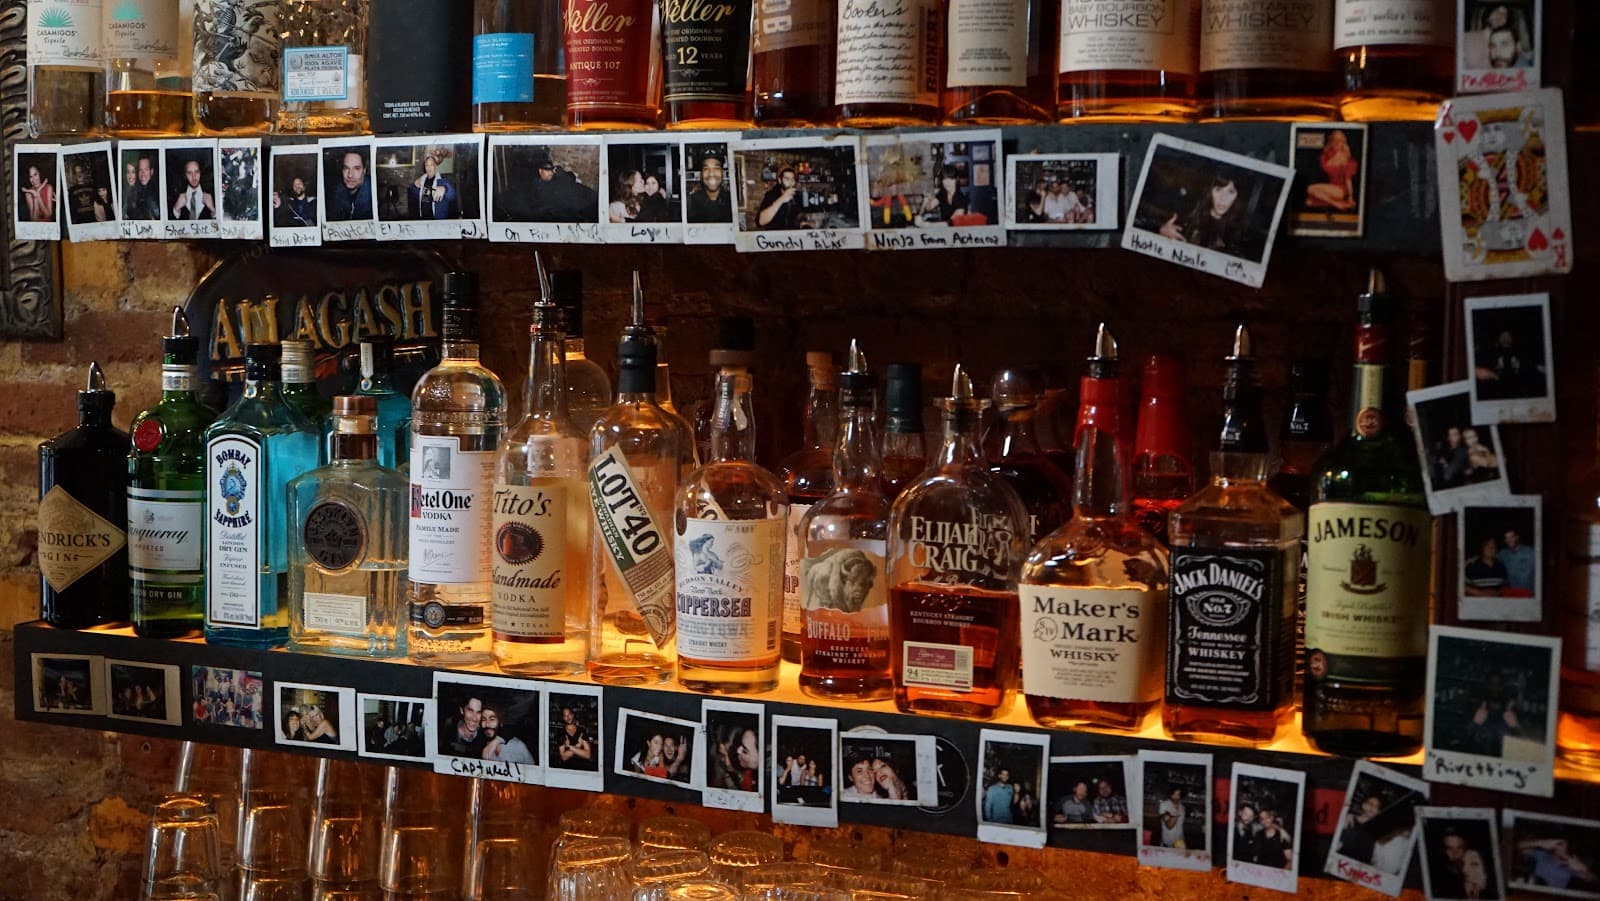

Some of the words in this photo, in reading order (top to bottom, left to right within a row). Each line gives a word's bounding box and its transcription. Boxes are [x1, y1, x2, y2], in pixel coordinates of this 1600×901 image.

[563, 0, 636, 34] Weller
[1068, 13, 1164, 29] WHISKEY
[1206, 13, 1313, 30] WHISKEY
[677, 46, 698, 65] 12
[570, 61, 601, 71] ANTIQUE
[604, 61, 621, 70] 107
[215, 449, 252, 469] BOMBAY
[442, 490, 472, 509] One
[494, 491, 551, 517] Tito's
[594, 453, 640, 515] LOT
[621, 515, 660, 556] 40
[214, 508, 253, 529] SAPPHIRE
[422, 511, 453, 520] VODKA
[39, 532, 112, 547] NDRICK'S
[911, 515, 979, 548] ELIJAH
[1314, 517, 1419, 545] JAMESON
[47, 552, 72, 562] GIN
[909, 541, 978, 573] CRAIG
[1174, 568, 1209, 595] JACK
[1209, 562, 1265, 601] DANIEL'S
[167, 591, 183, 600] GIN
[497, 592, 537, 604] VODKA
[910, 610, 943, 618] KENTUCKY
[1032, 595, 1141, 619] Maker's
[1321, 610, 1350, 620] IRISH
[807, 615, 851, 642] BUFFALO
[1061, 622, 1140, 643] Mark
[1187, 625, 1248, 643] Tennessee
[1049, 649, 1121, 662] WHISKY
[1188, 646, 1247, 660] WHISKEY
[906, 668, 919, 678] 94
